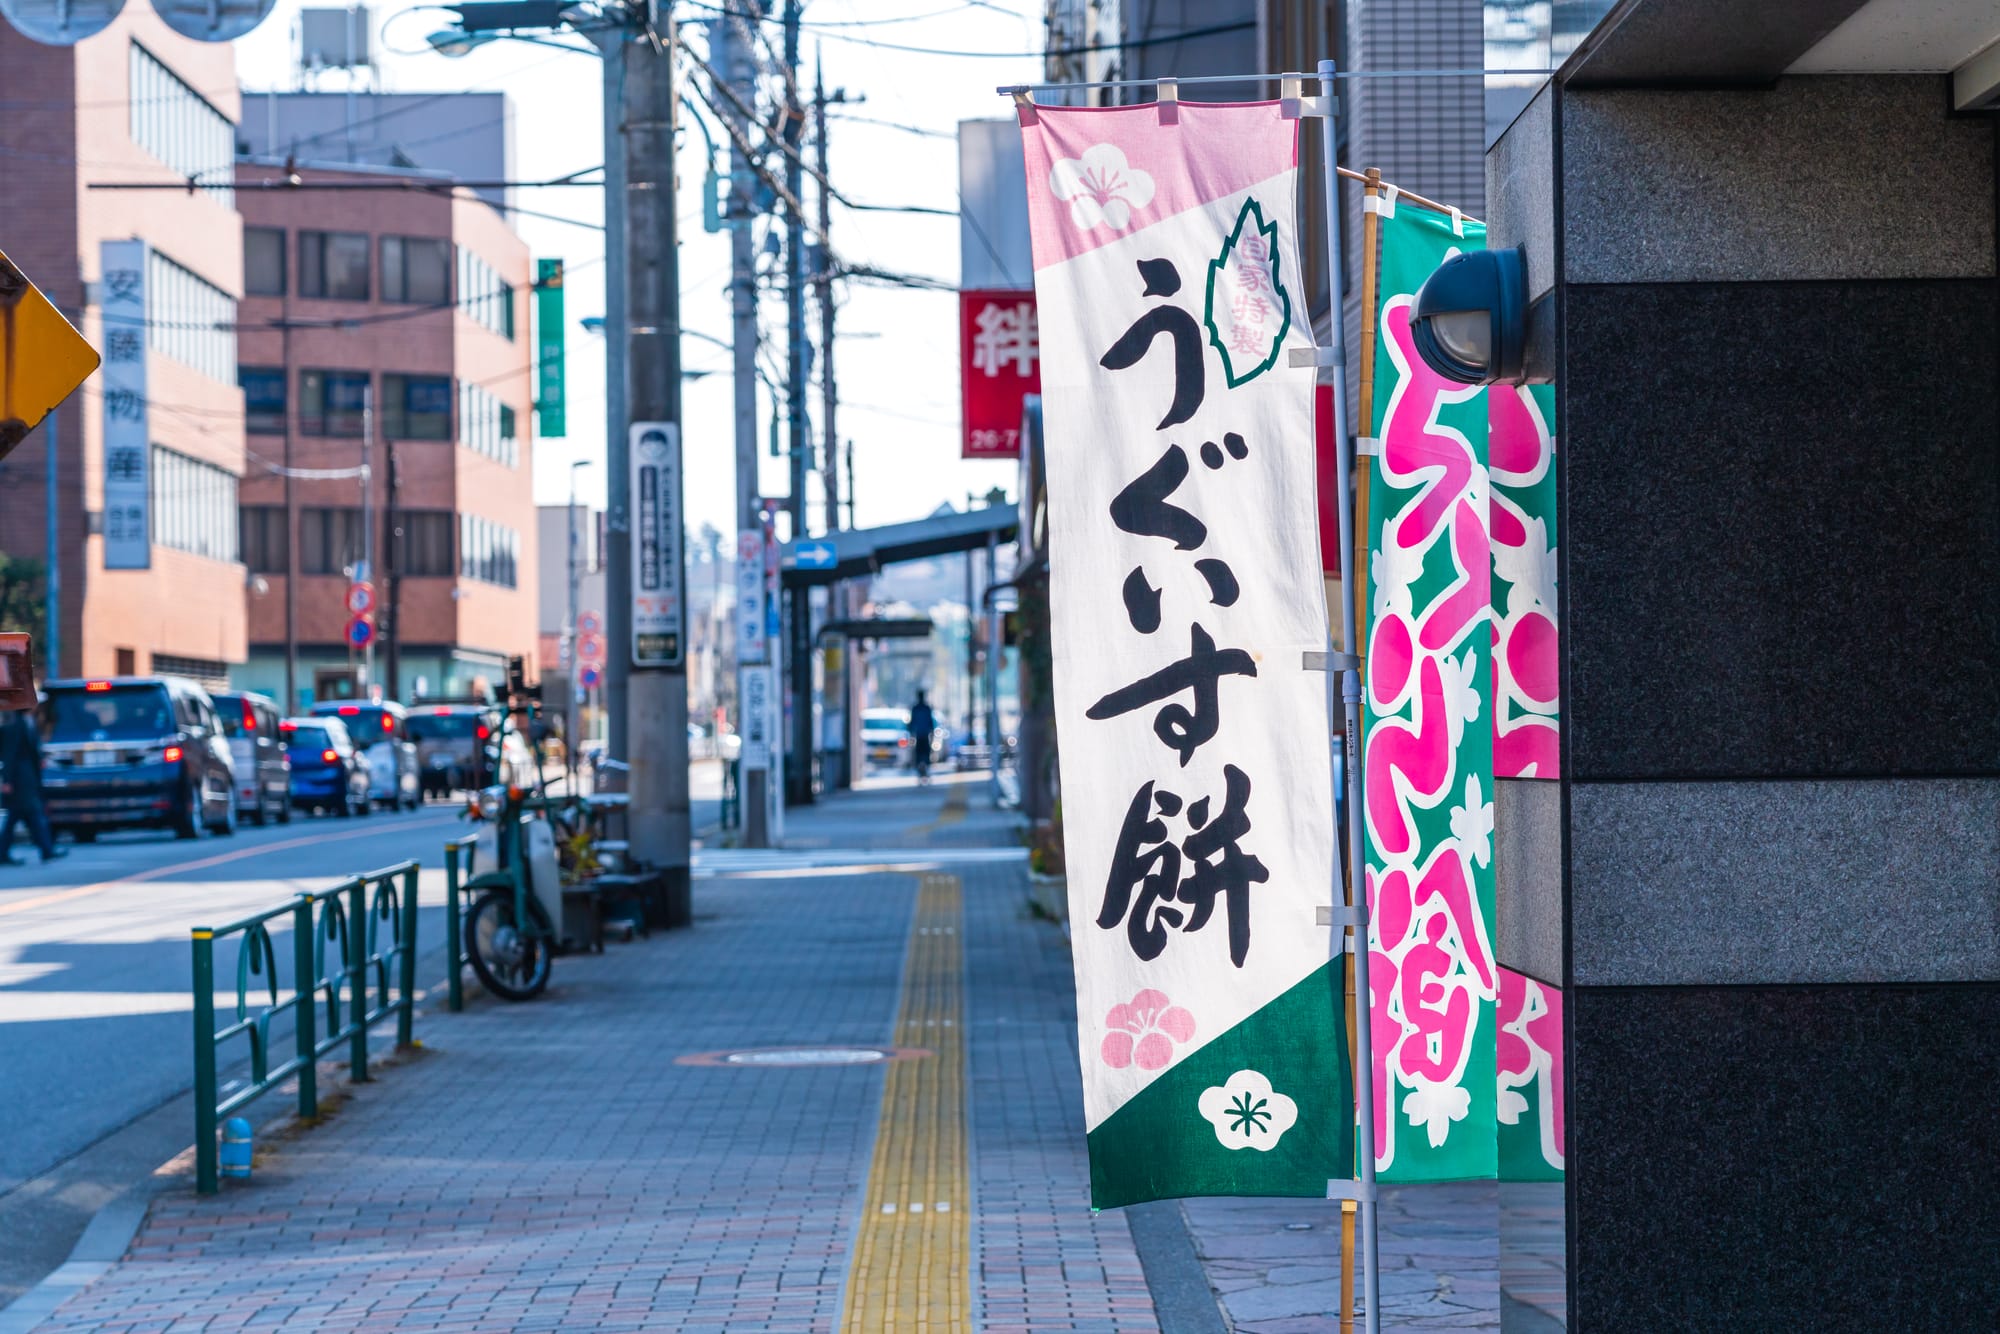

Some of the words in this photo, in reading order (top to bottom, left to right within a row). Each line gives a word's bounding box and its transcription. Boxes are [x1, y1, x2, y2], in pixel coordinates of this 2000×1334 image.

[1227, 234, 1271, 358] 自家特製
[1086, 257, 1270, 969] うぐいす餅
